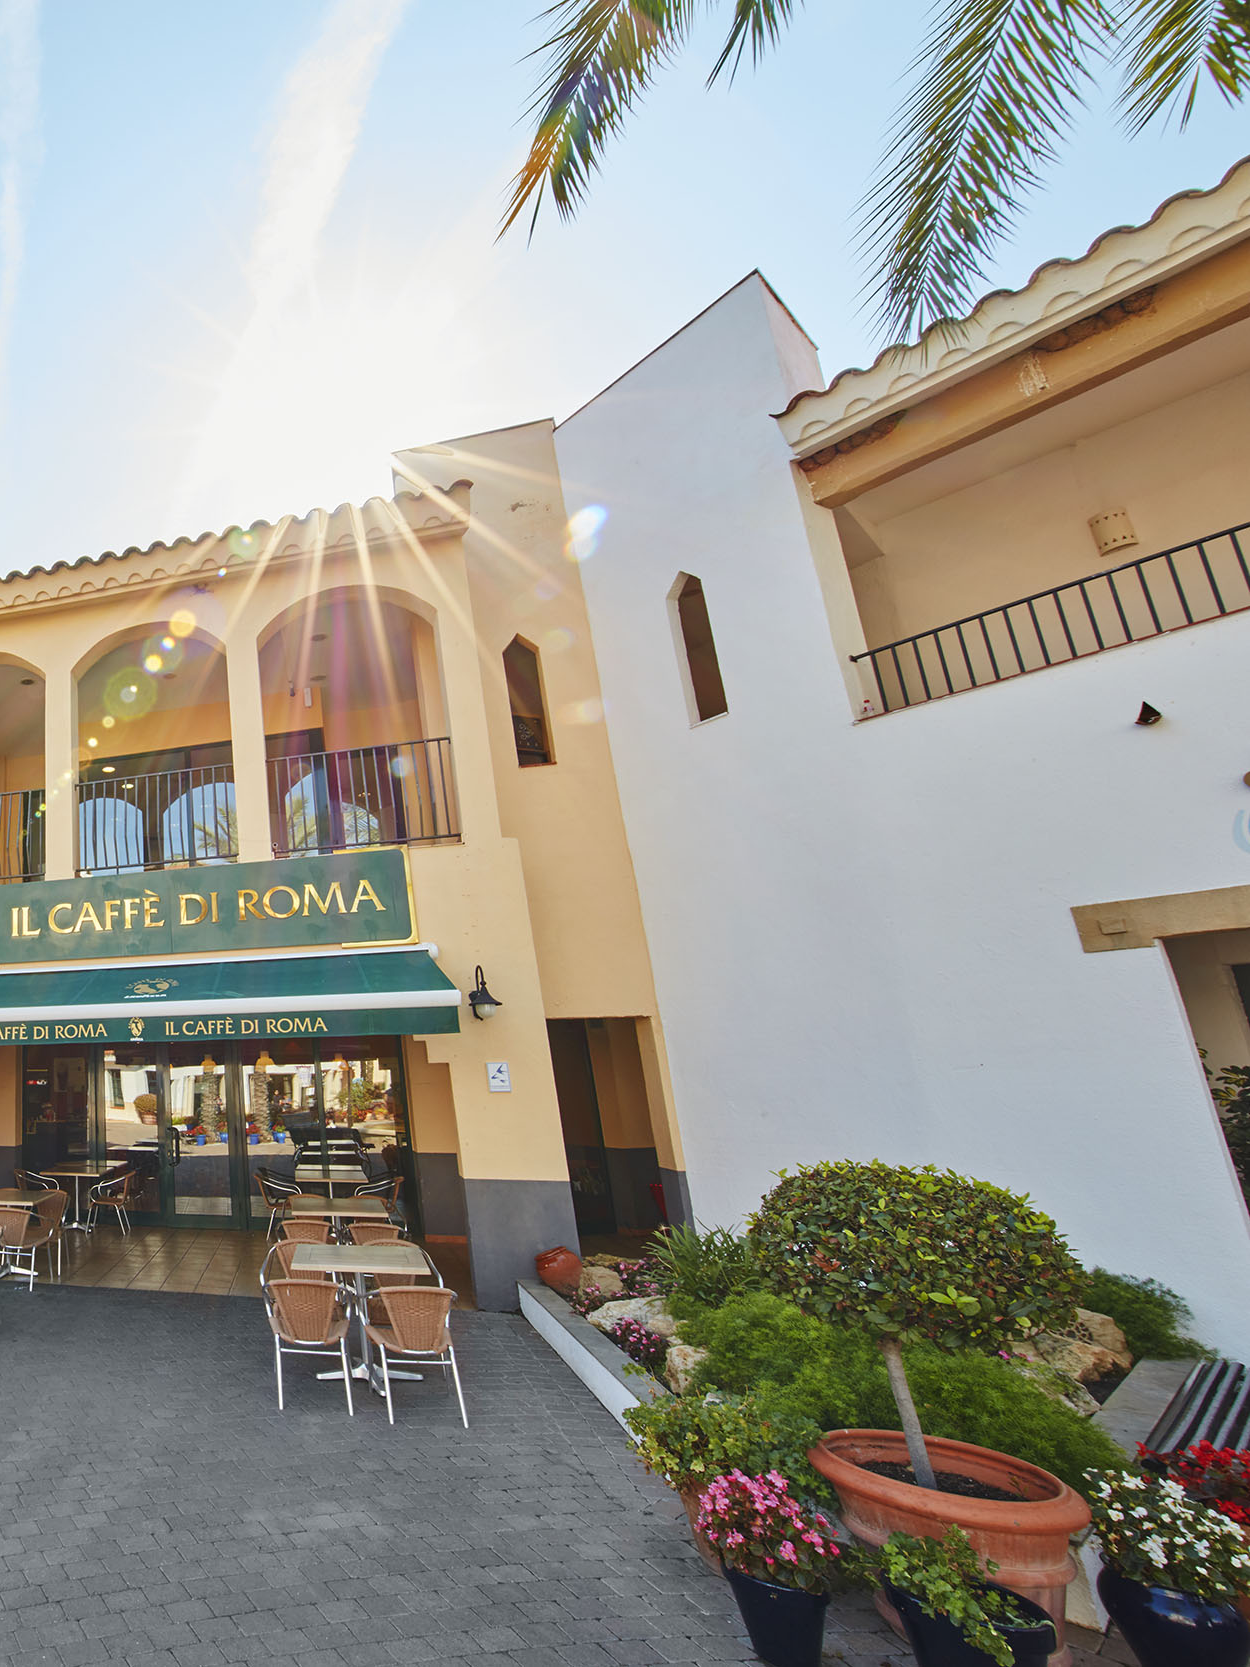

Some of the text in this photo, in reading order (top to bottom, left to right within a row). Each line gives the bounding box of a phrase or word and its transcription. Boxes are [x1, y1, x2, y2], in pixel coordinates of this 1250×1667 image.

[11, 879, 387, 938] IL CAFFÈ DI ROMA
[33, 1026, 49, 1040] DI
[55, 1023, 108, 1040] ROMA
[165, 1017, 328, 1036] IL CAFFÈ DI ROMA
